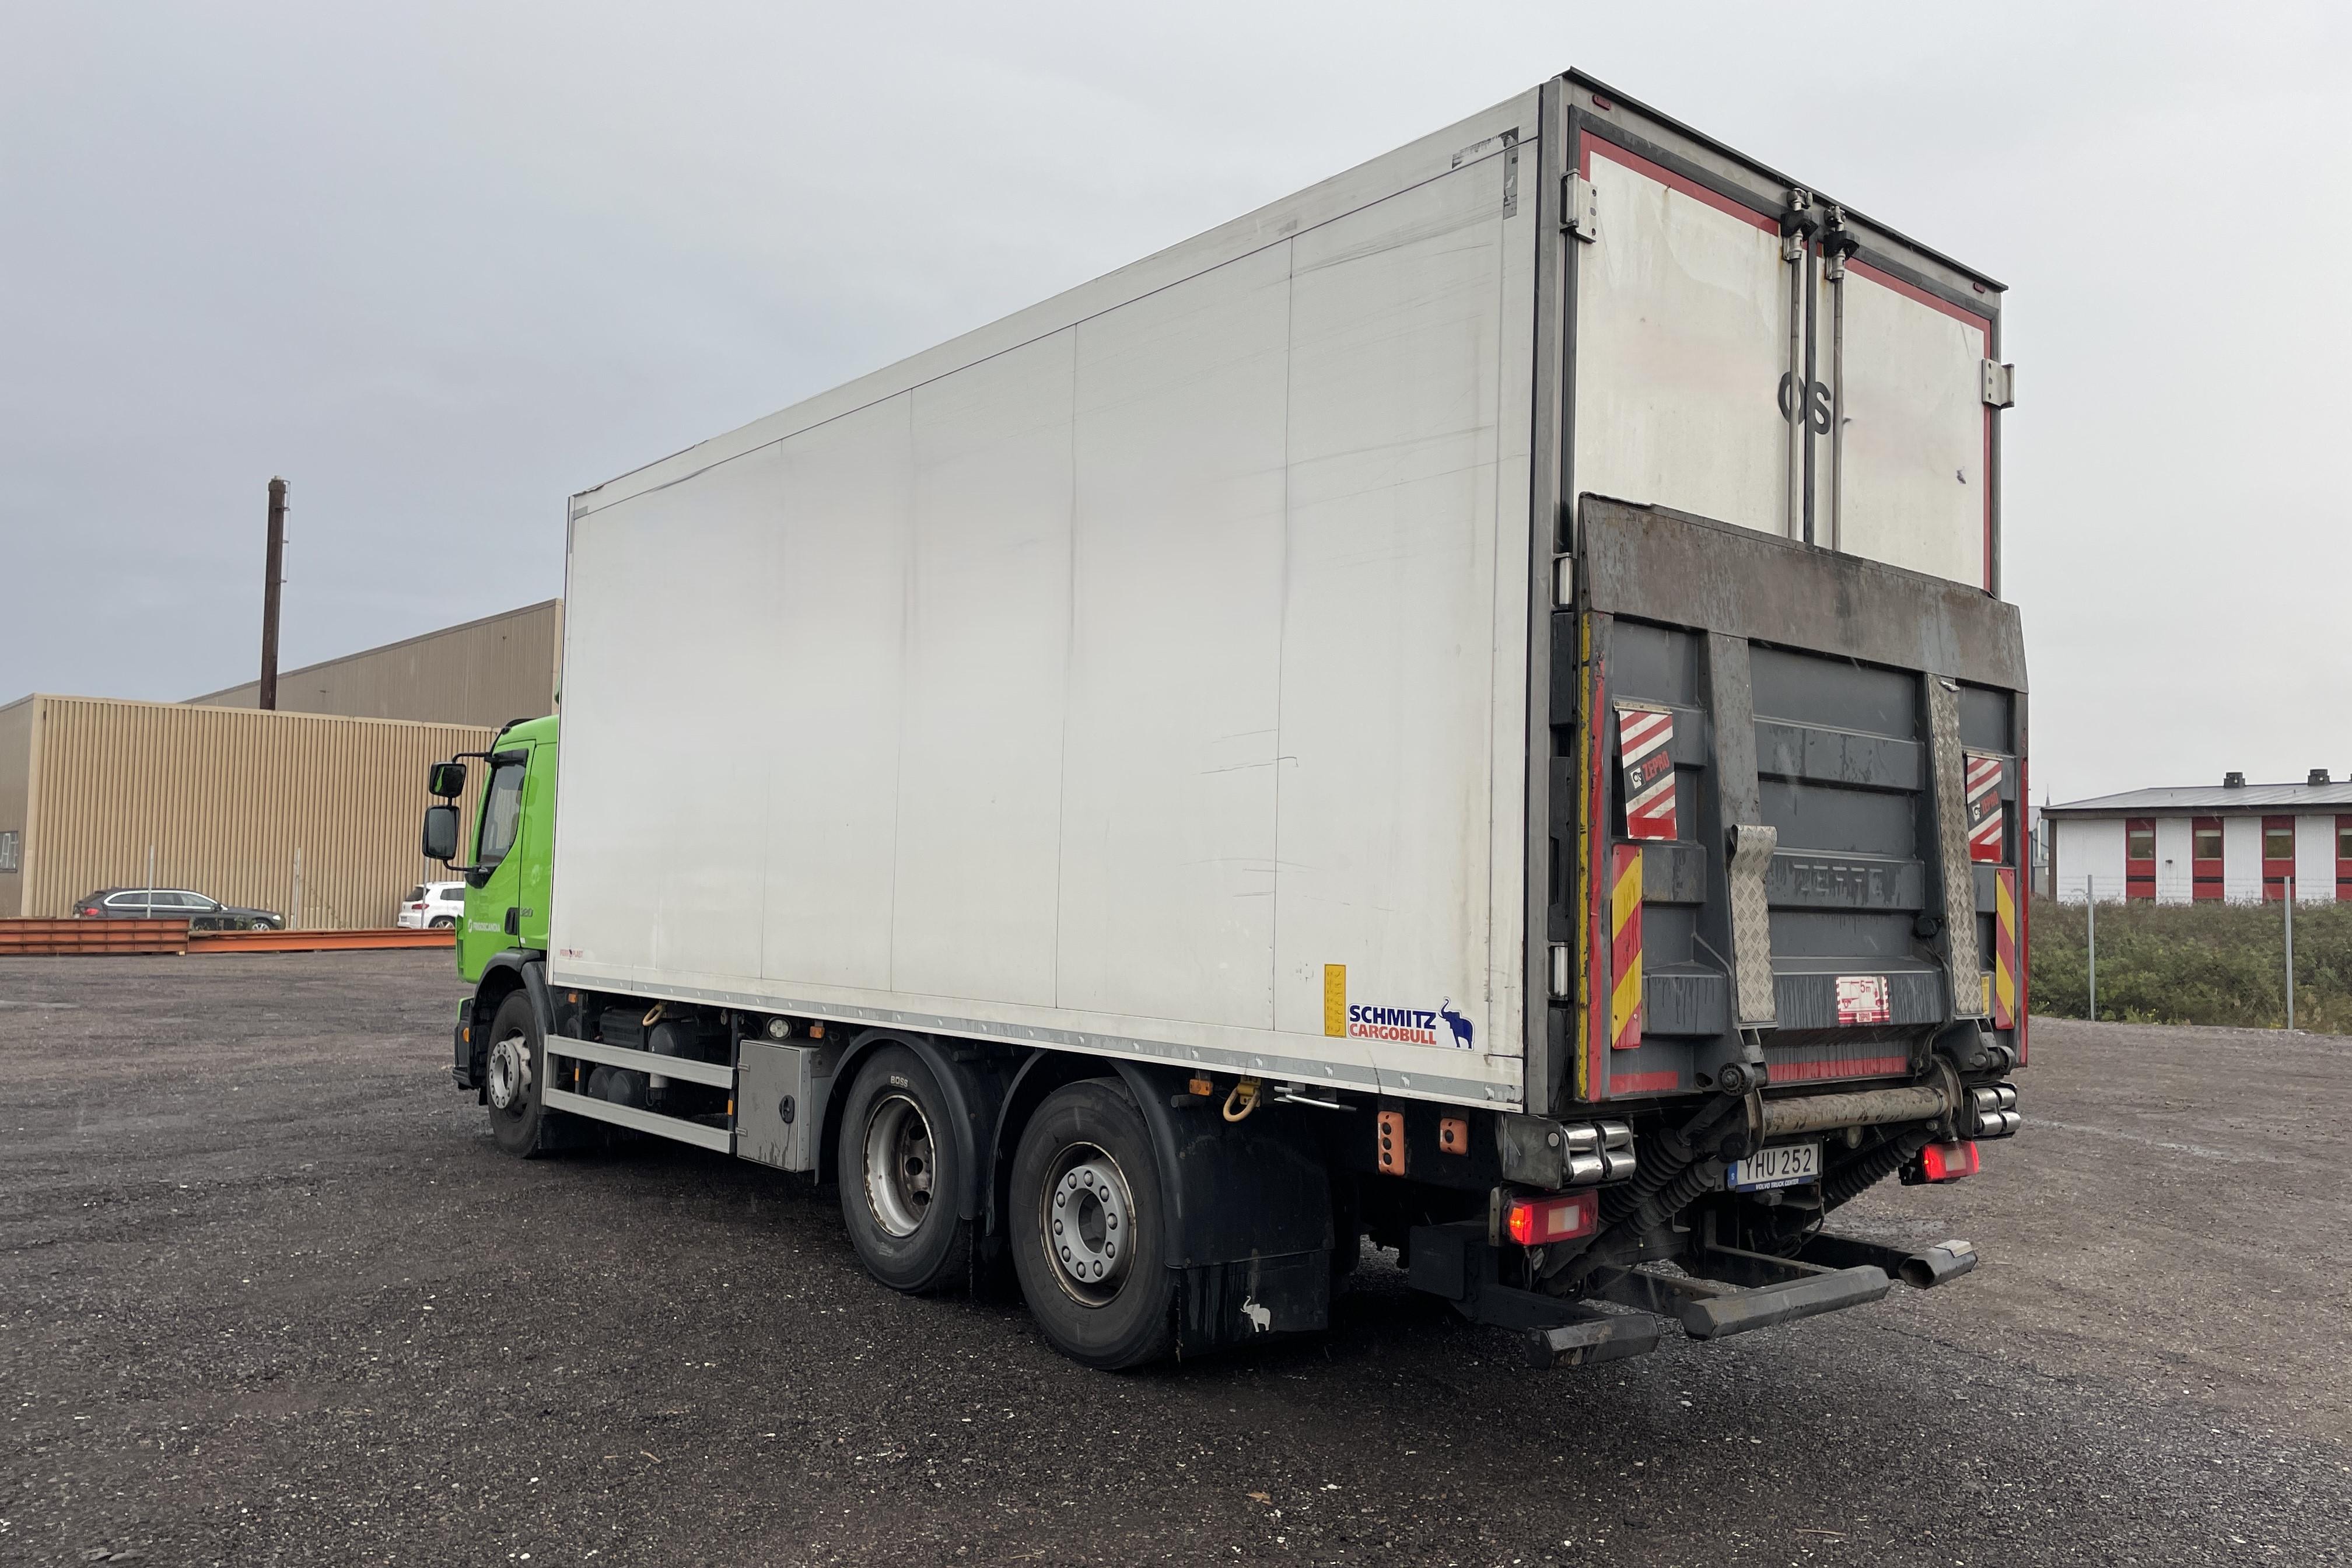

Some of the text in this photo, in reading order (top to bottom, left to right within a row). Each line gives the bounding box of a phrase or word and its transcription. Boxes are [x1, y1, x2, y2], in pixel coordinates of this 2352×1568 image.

[1642, 750, 1670, 782] ZEPRO
[1980, 790, 1999, 816] ZEPRO
[1349, 1005, 1436, 1030] SCHMITZ
[1349, 1023, 1437, 1045] CARGOBULL
[890, 1075, 909, 1087] BOSS
[1745, 1148, 1811, 1180] YHU 252
[1755, 1182, 1770, 1191] VOLVO
